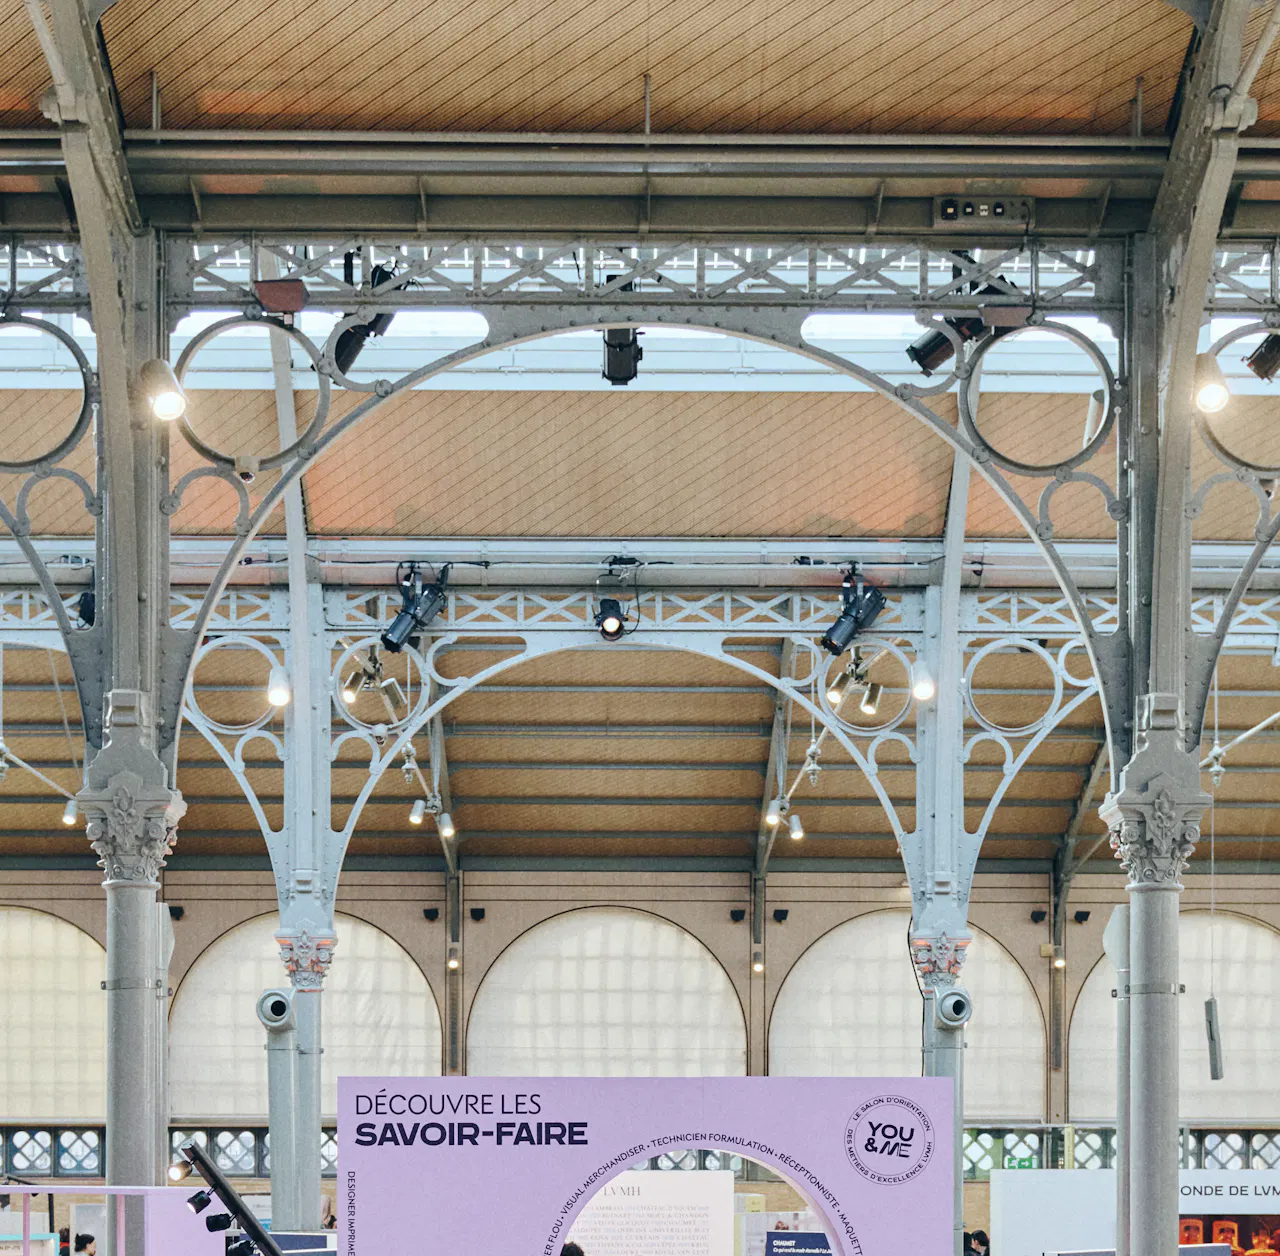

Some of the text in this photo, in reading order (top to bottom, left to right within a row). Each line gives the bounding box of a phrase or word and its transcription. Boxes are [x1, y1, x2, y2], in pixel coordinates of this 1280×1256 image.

[355, 1088, 541, 1115] DÉCOUVRE LES
[853, 1097, 931, 1132] LE SALON D'ORIENTATION
[355, 1122, 588, 1146] SAVOIR-FAIRE
[868, 1121, 914, 1142] YOU
[870, 1163, 924, 1183] D'EXCELLENCE
[922, 1141, 932, 1162] LVMH
[347, 1171, 356, 1217] DESIGNER
[548, 1219, 564, 1244] FLOU
[561, 1188, 585, 1214] VISUAL
[583, 1144, 646, 1190] MERCHANDISER
[650, 1132, 707, 1148] TECHNICIEN
[708, 1133, 775, 1156] FORMULATION
[778, 1153, 840, 1210] RÉCEPTIONNISTE
[603, 1186, 641, 1196] LVMH
[1180, 1185, 1223, 1196] ONDE
[1229, 1185, 1249, 1196] DE
